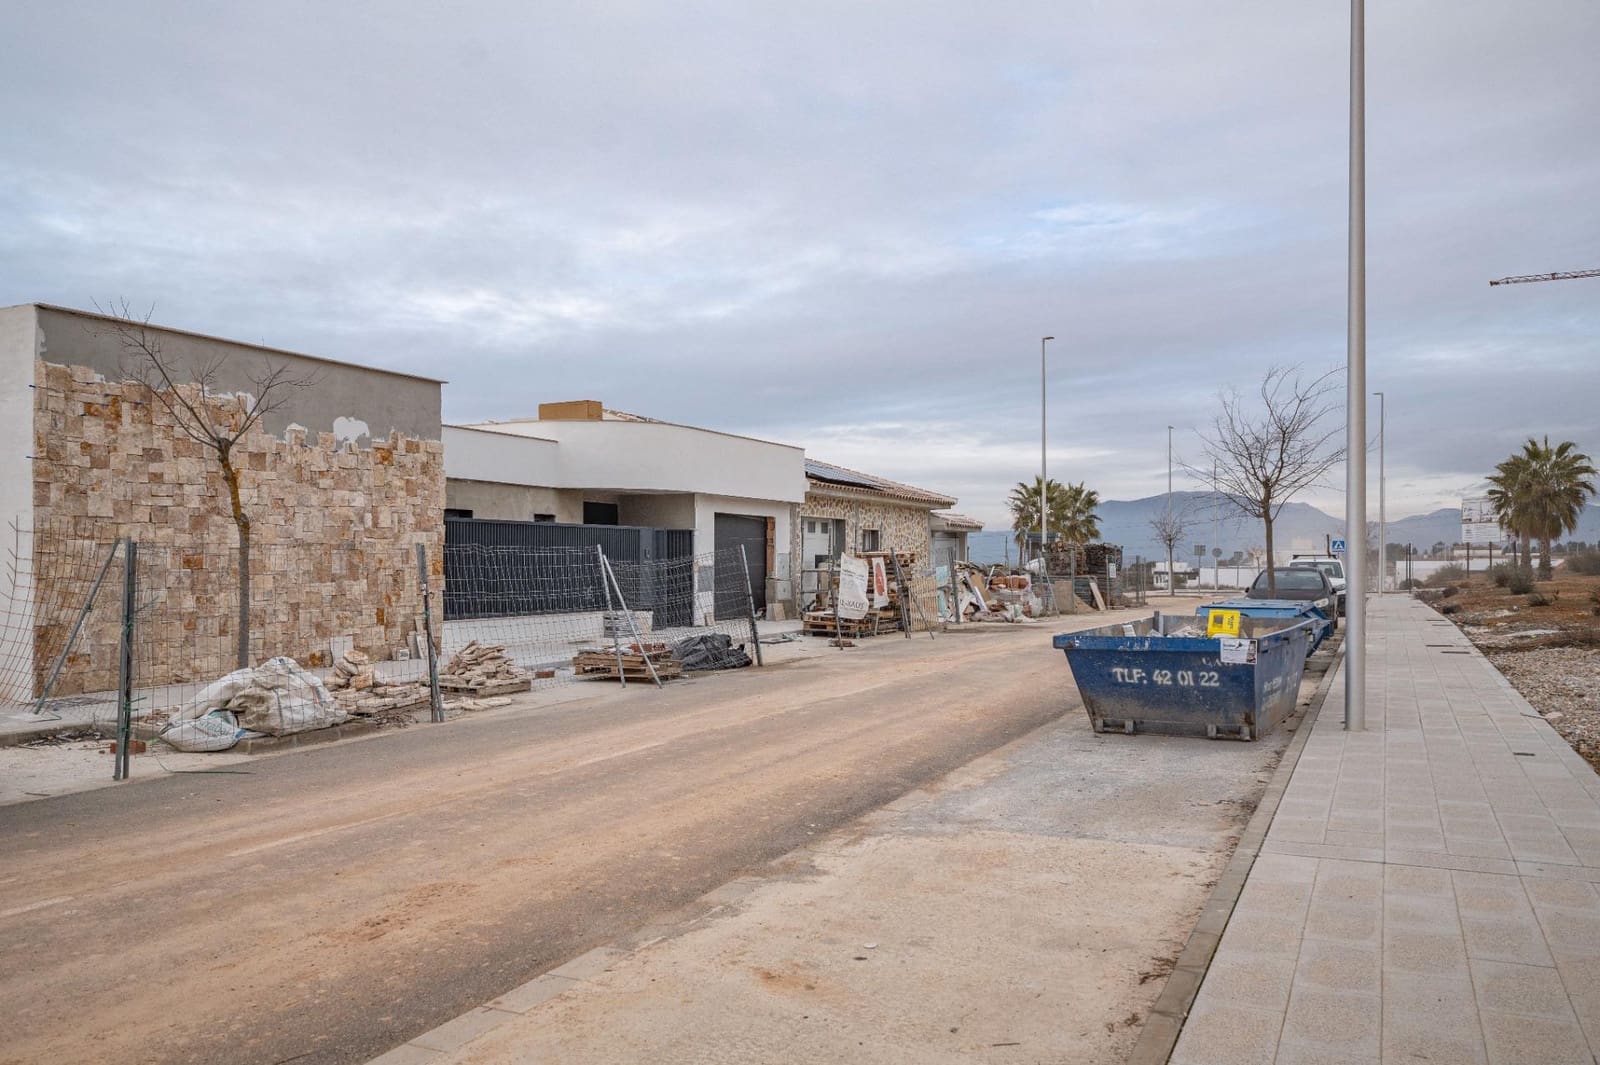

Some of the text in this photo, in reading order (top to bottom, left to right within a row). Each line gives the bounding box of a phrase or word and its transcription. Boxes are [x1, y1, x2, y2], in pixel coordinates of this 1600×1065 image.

[1112, 667, 1148, 685] TLF:
[1153, 669, 1172, 686] 42
[1199, 671, 1220, 688] 22
